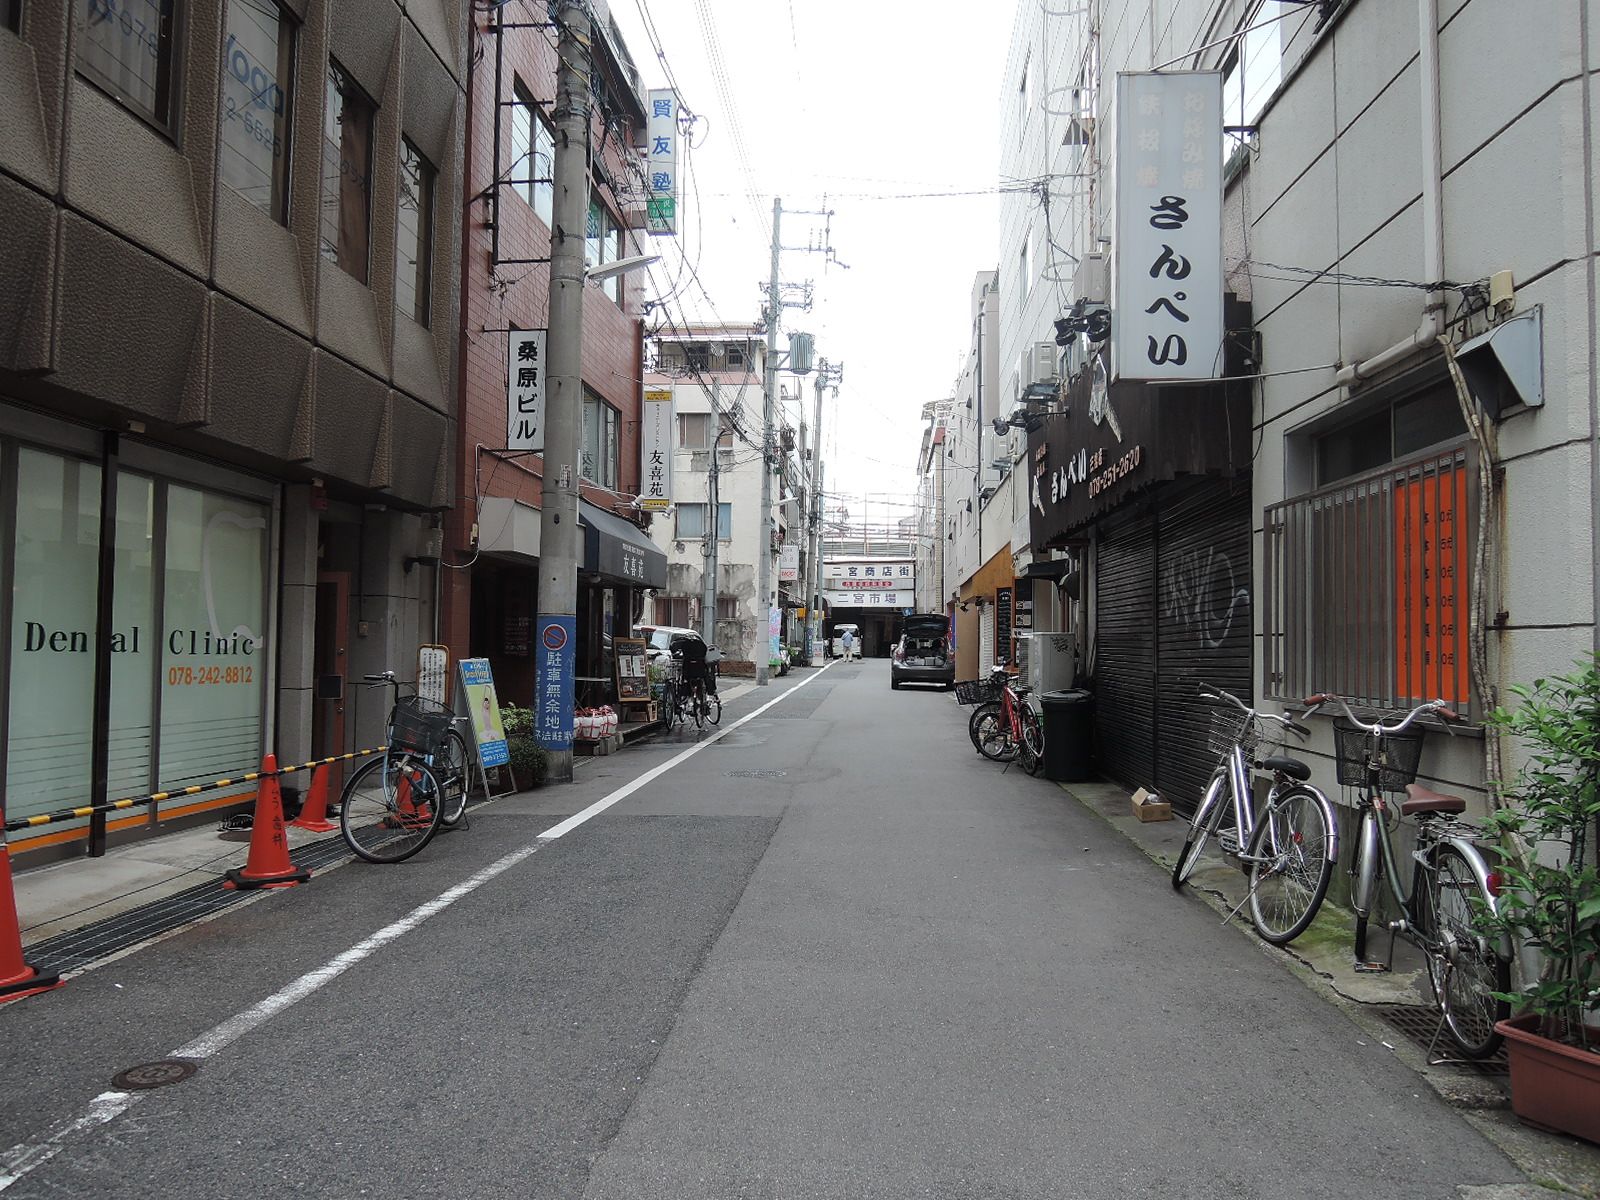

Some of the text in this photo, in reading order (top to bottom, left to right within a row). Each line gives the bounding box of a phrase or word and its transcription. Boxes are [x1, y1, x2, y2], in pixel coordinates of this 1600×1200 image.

[652, 99, 672, 192] 賢友塾
[1145, 195, 1192, 366] さんぺい
[516, 341, 538, 441] 桑原ビル
[648, 450, 665, 497] 友喜苑
[1050, 447, 1087, 505] さんぺい
[1088, 445, 1141, 499] 078-251-2620
[832, 566, 909, 577] 二宮商店街
[837, 593, 897, 604] 二宮市場
[24, 621, 254, 656] Denal Clinic
[168, 666, 253, 686] 078-242-8812
[545, 652, 563, 730] 駐車無余地
